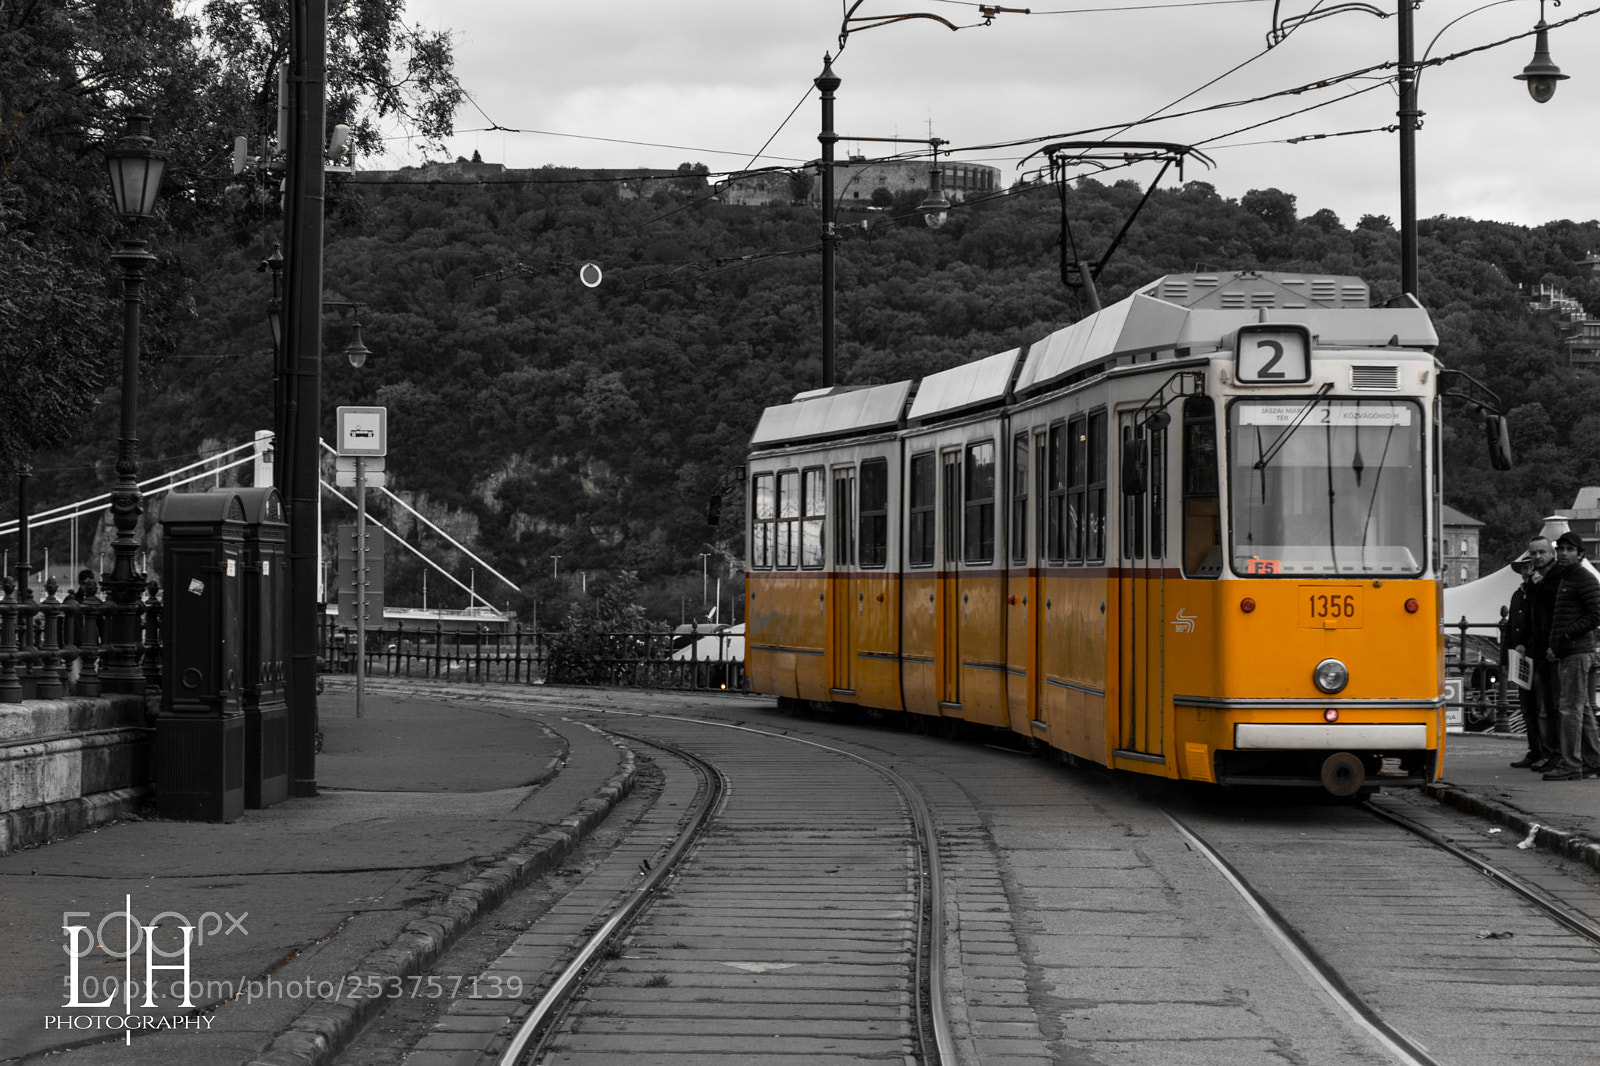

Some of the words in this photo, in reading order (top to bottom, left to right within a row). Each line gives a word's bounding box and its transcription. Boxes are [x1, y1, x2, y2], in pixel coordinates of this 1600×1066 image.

[1257, 339, 1285, 379] 2
[1320, 408, 1331, 424] 2
[1254, 562, 1274, 574] F5
[1309, 595, 1355, 618] 1356
